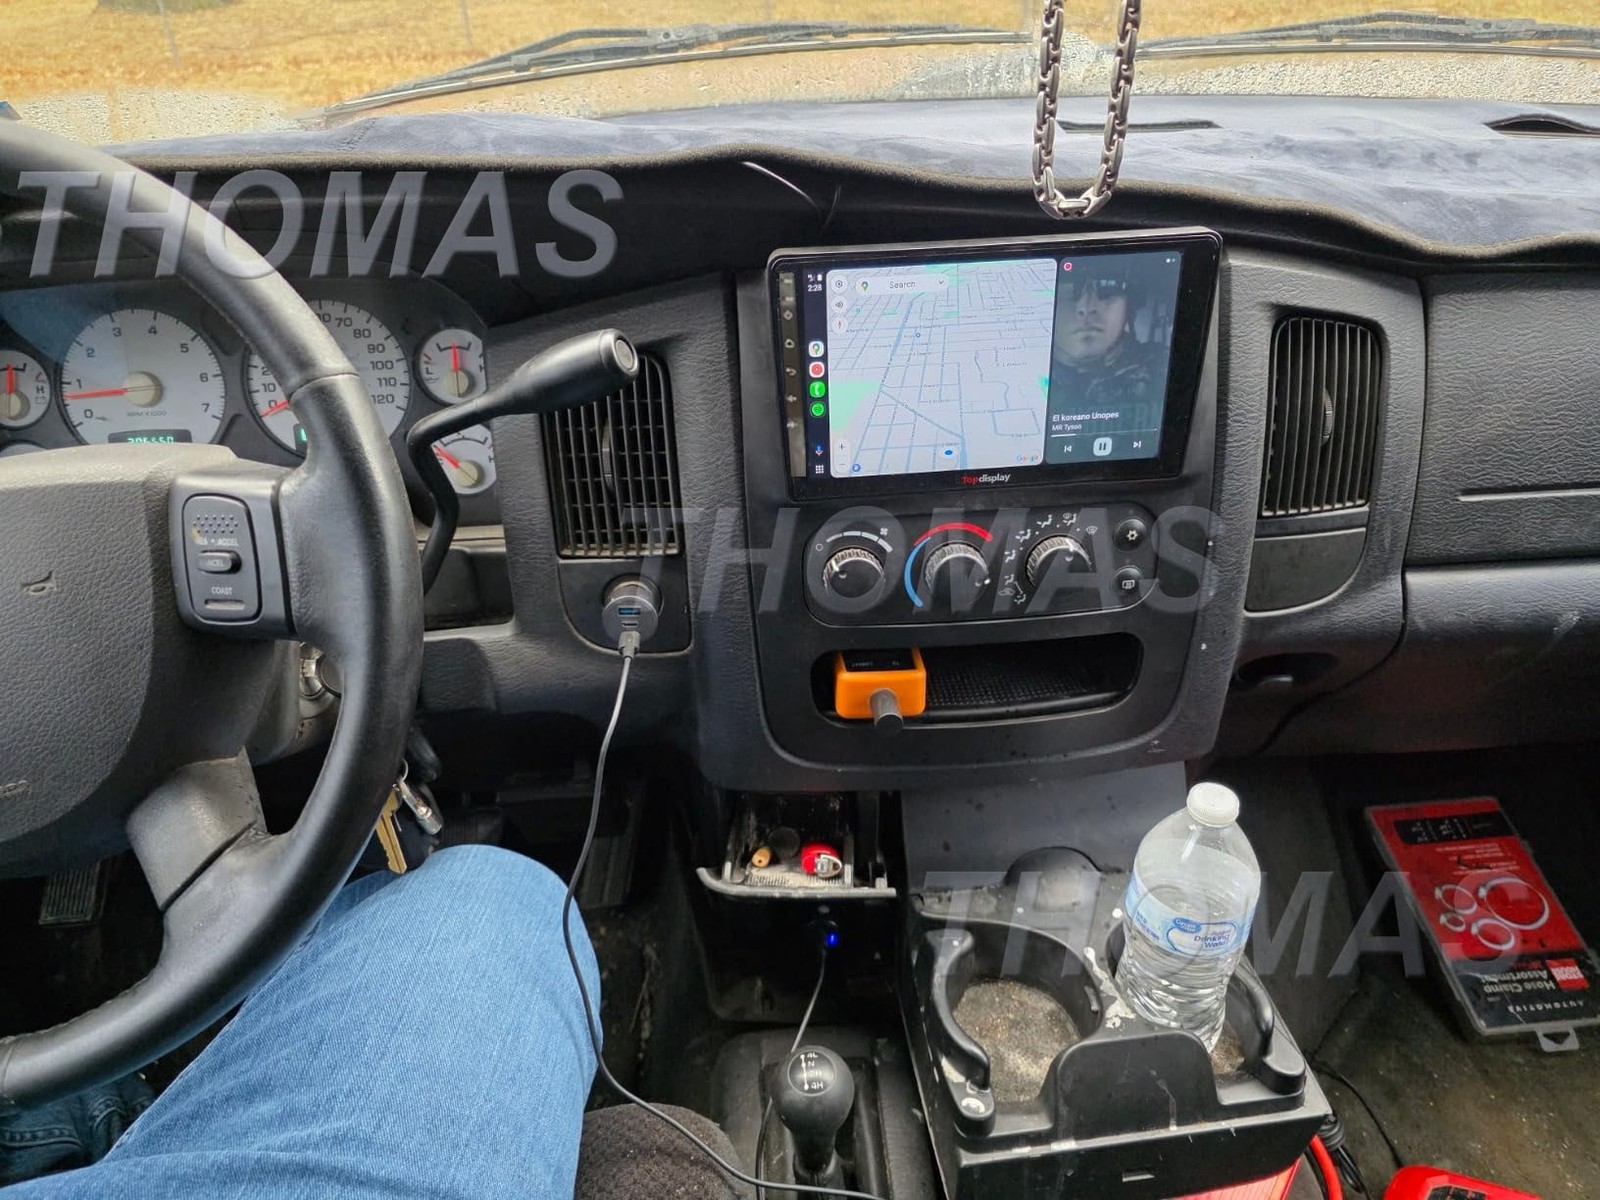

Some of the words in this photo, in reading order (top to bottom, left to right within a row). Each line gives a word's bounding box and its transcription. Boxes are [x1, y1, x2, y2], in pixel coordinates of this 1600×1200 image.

[889, 281, 916, 289] Search
[316, 313, 331, 323] 0
[335, 317, 353, 328] 70
[113, 327, 122, 337] 3
[148, 326, 158, 335] 4
[353, 329, 371, 338] 80
[87, 348, 95, 357] 2
[180, 343, 189, 353] 5
[367, 343, 386, 353] 90
[369, 360, 394, 370] 100
[199, 373, 208, 383] 6
[377, 377, 397, 387] 110
[76, 379, 82, 389] 1
[262, 383, 277, 393] 10
[36, 385, 45, 394] H
[371, 394, 395, 404] 120
[202, 403, 210, 412] 7
[84, 409, 93, 418] 0
[1061, 413, 1090, 421] koreano
[961, 473, 1012, 485] Topdisplay
[217, 538, 240, 546] ACCEL
[211, 586, 233, 595] COAST
[1194, 933, 1230, 943] Drinking
[1483, 982, 1523, 993] Clamp
[1524, 980, 1556, 990] Hose
[811, 1081, 824, 1090] 4H
